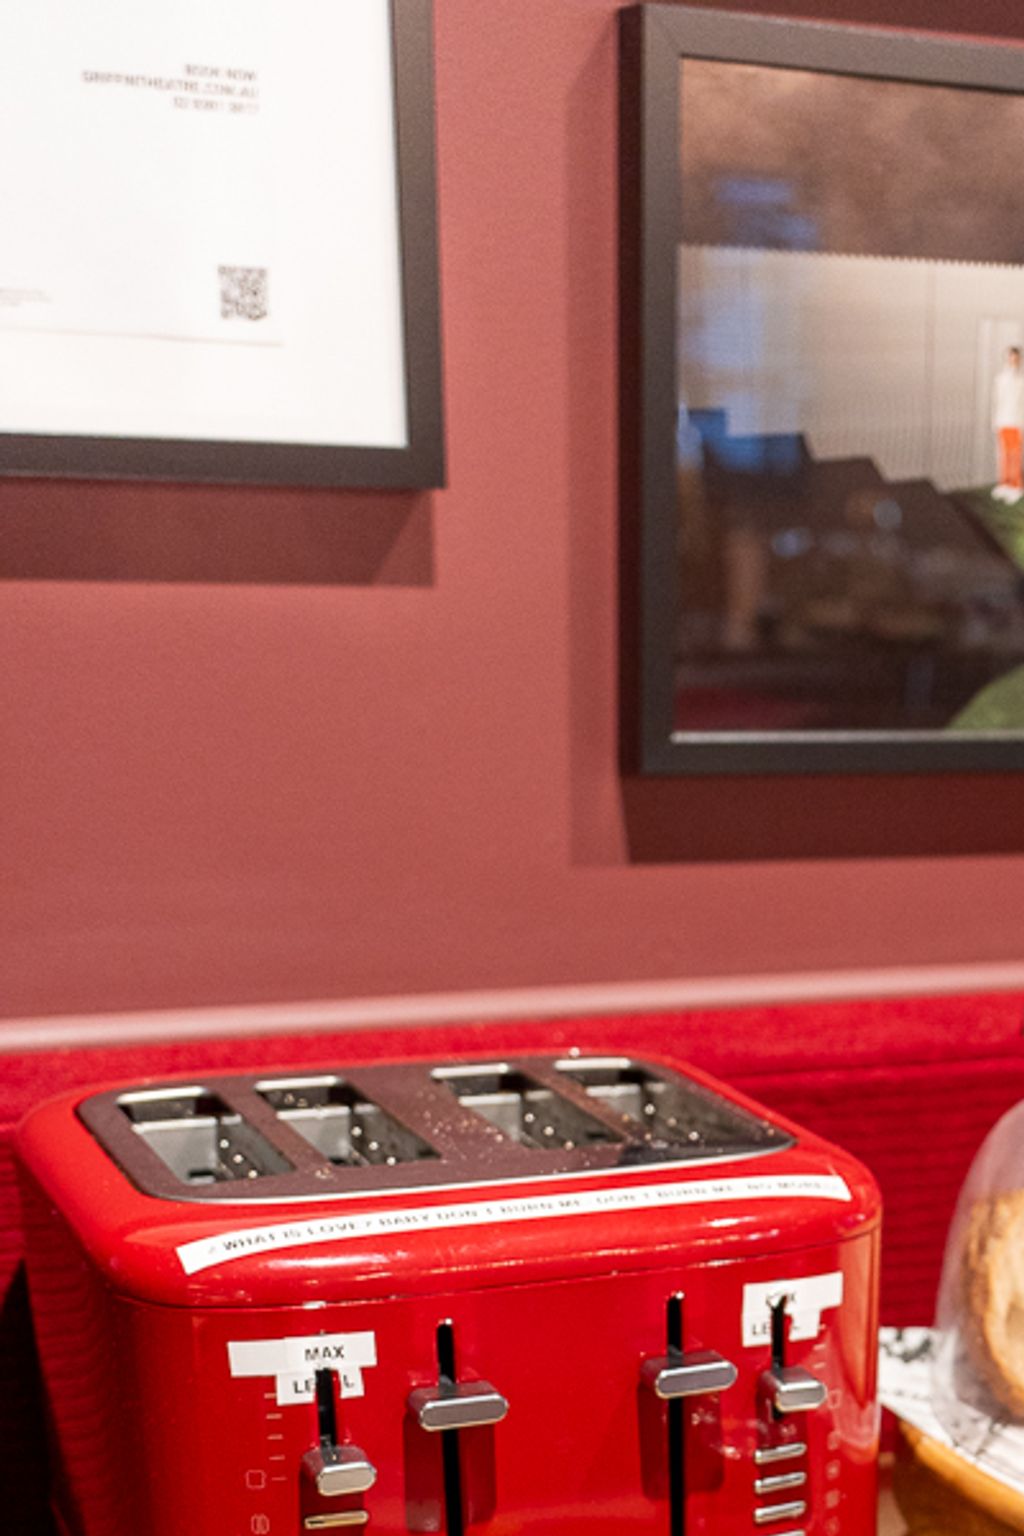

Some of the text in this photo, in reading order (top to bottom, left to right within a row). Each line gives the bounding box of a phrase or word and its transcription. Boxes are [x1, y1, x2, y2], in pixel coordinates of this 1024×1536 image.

[436, 1206, 493, 1221] DONT
[305, 1345, 345, 1361] MAX
[293, 1374, 355, 1394] LEL
